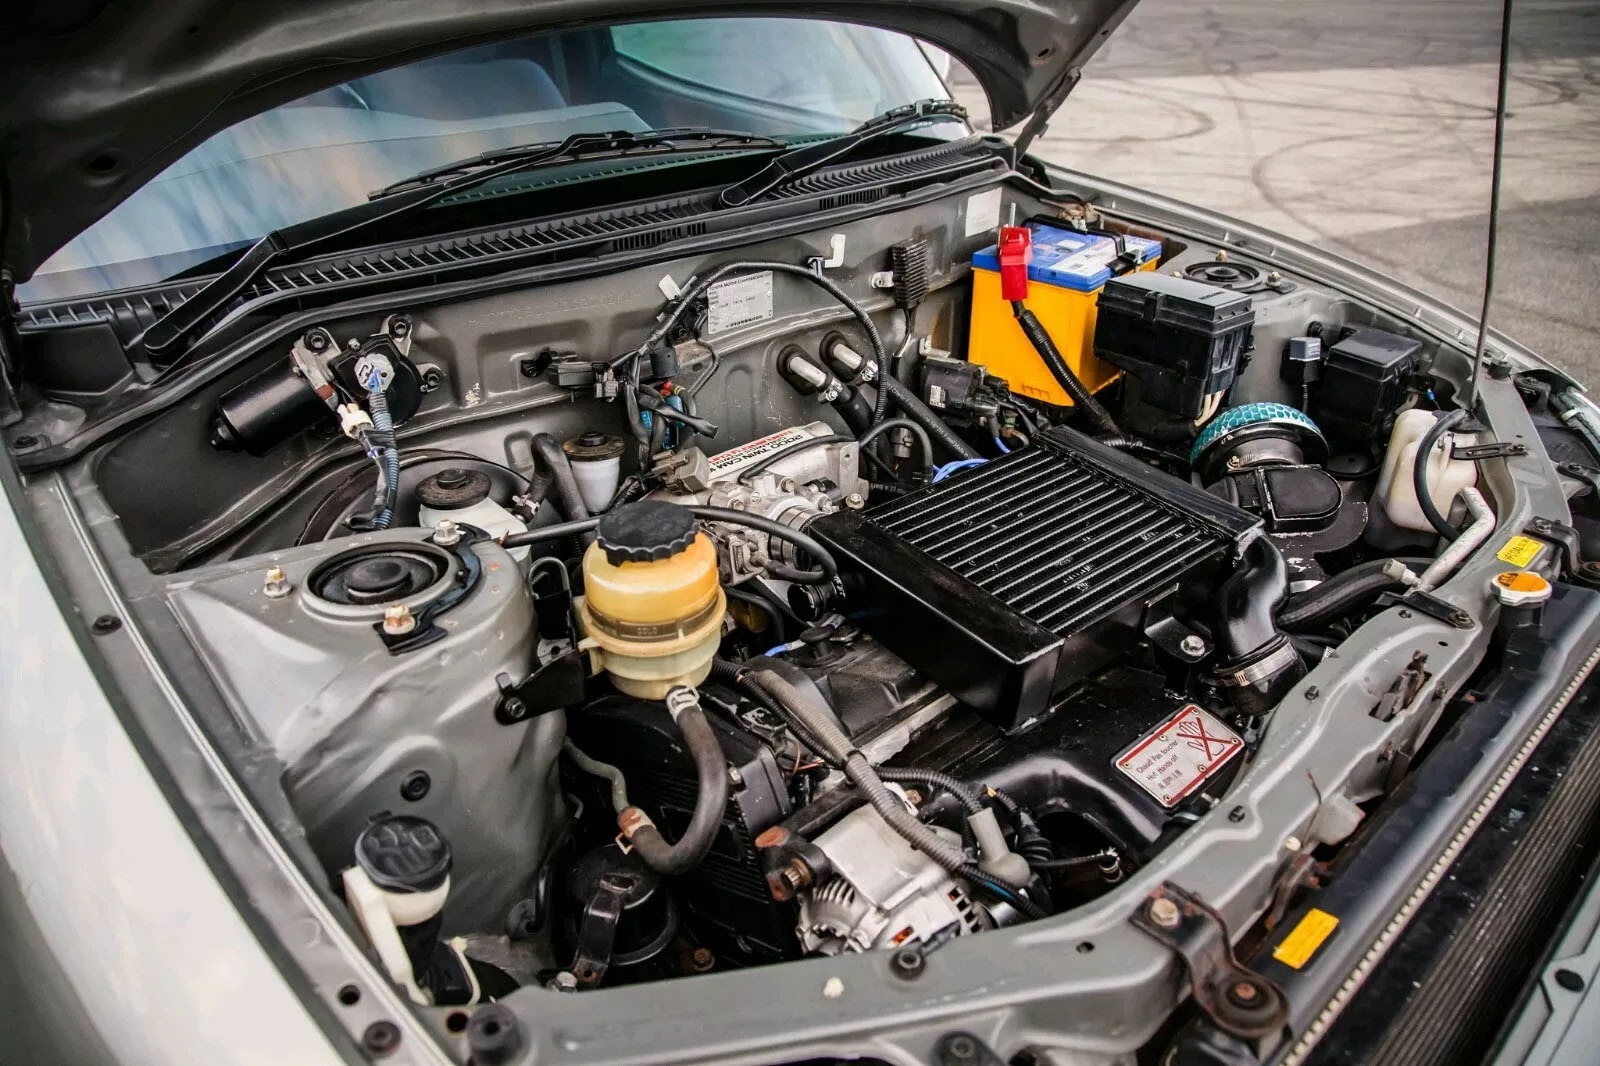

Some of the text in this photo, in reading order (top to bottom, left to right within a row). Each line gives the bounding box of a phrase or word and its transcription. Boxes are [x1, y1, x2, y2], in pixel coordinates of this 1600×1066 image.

[771, 434, 804, 449] 2000
[744, 447, 771, 460] TWIN
[716, 457, 742, 470] CAM
[1151, 753, 1163, 762] Pas
[1156, 760, 1173, 774] Hands
[1170, 753, 1178, 763] off
